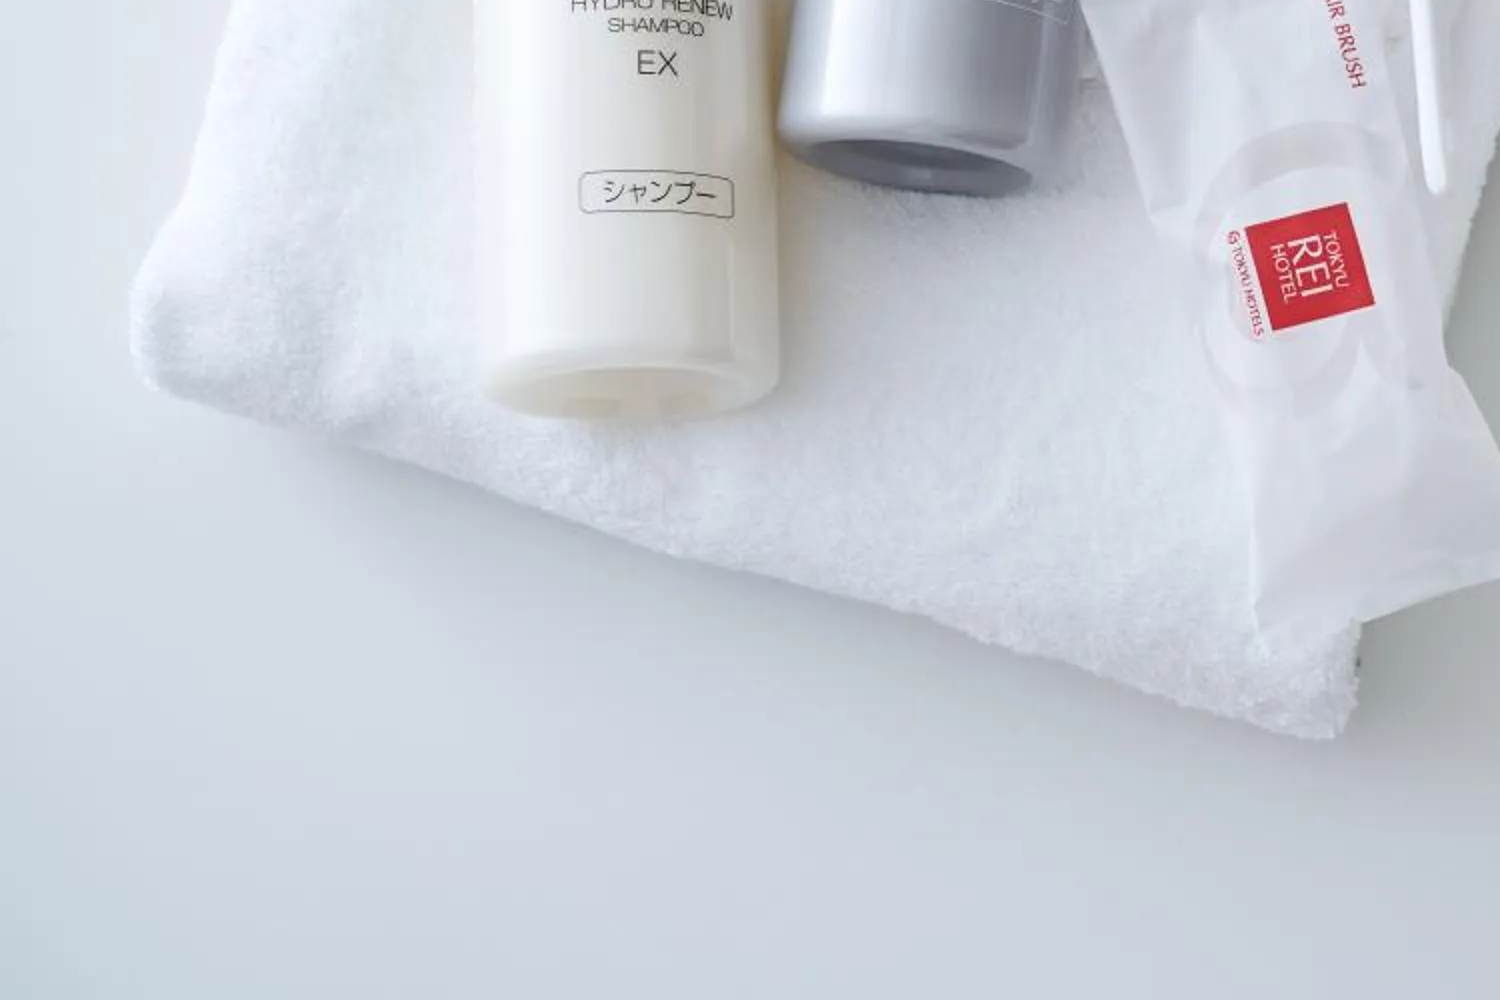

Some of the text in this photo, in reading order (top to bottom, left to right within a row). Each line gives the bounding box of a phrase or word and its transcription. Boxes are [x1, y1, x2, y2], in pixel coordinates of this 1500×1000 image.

[607, 16, 705, 38] SHAMPOO
[1335, 21, 1367, 89] BRUSH
[637, 50, 679, 77] EX
[602, 179, 718, 206] シャンプー
[1270, 243, 1297, 304] HOTEL
[1287, 234, 1333, 297] REI
[1323, 230, 1350, 287] TOKYU
[1232, 246, 1265, 337] TOKYU HOTELS
